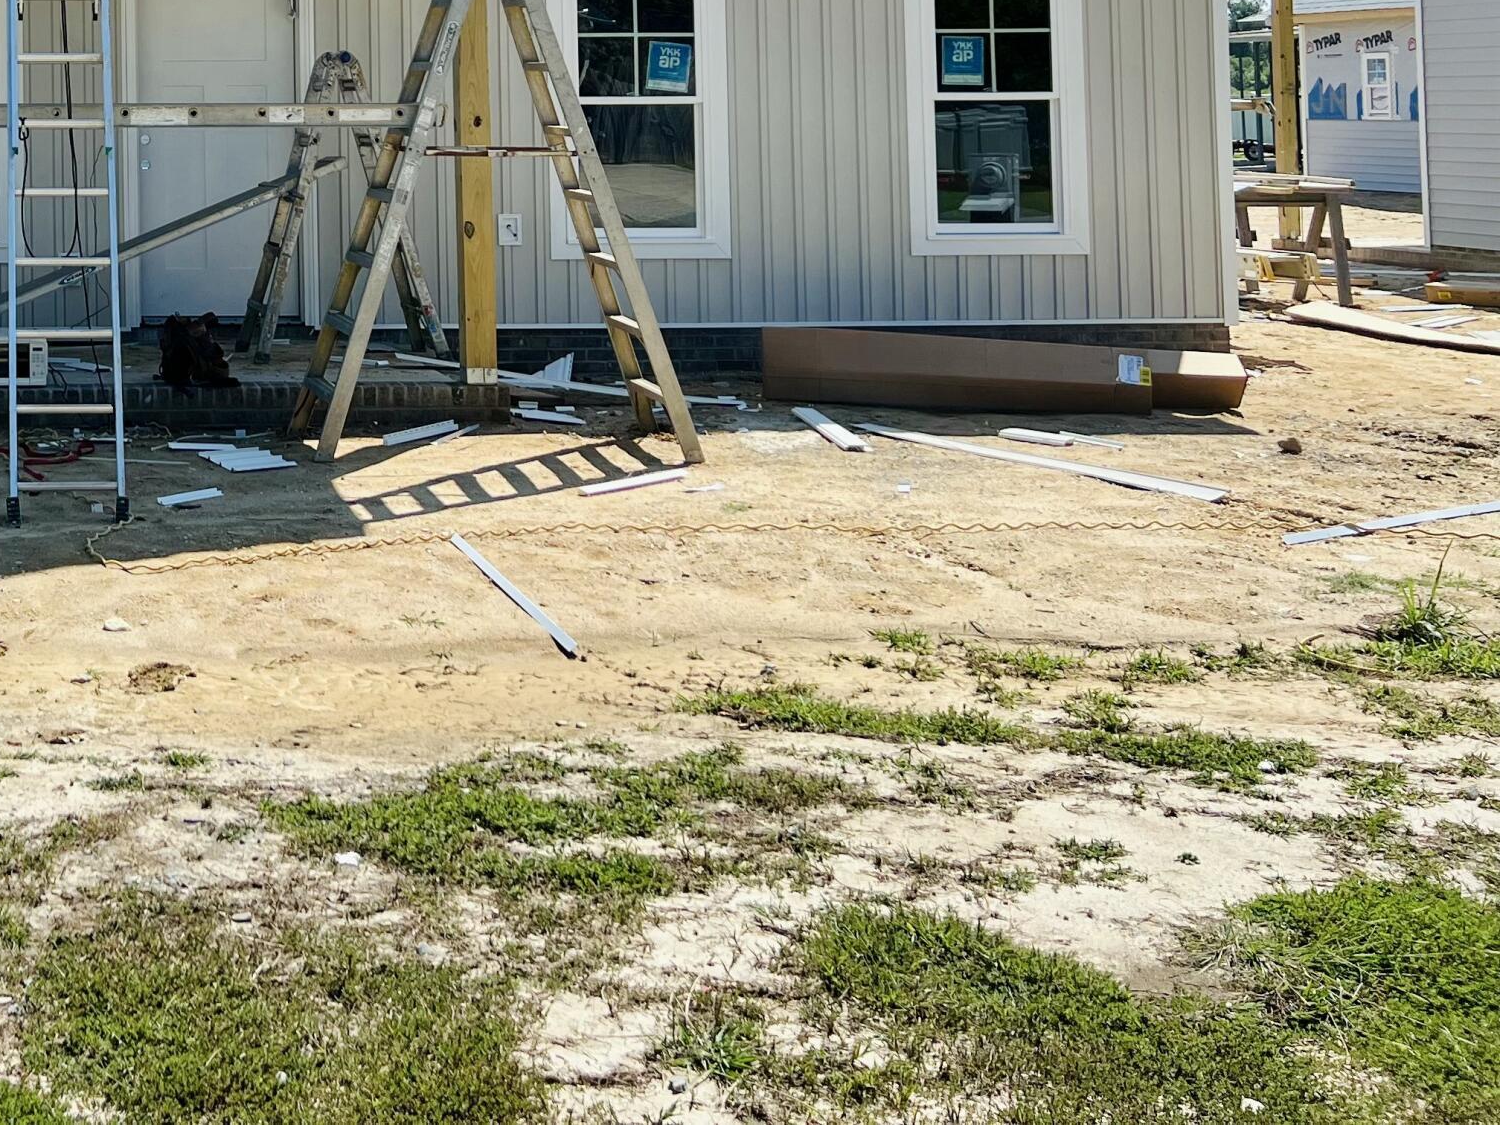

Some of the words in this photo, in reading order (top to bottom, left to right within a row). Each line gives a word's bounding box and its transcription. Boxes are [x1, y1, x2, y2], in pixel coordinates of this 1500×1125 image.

[952, 41, 973, 50] YKK
[1313, 32, 1342, 51] TYPAR
[1363, 30, 1393, 49] TYPAR
[660, 46, 681, 57] YKK
